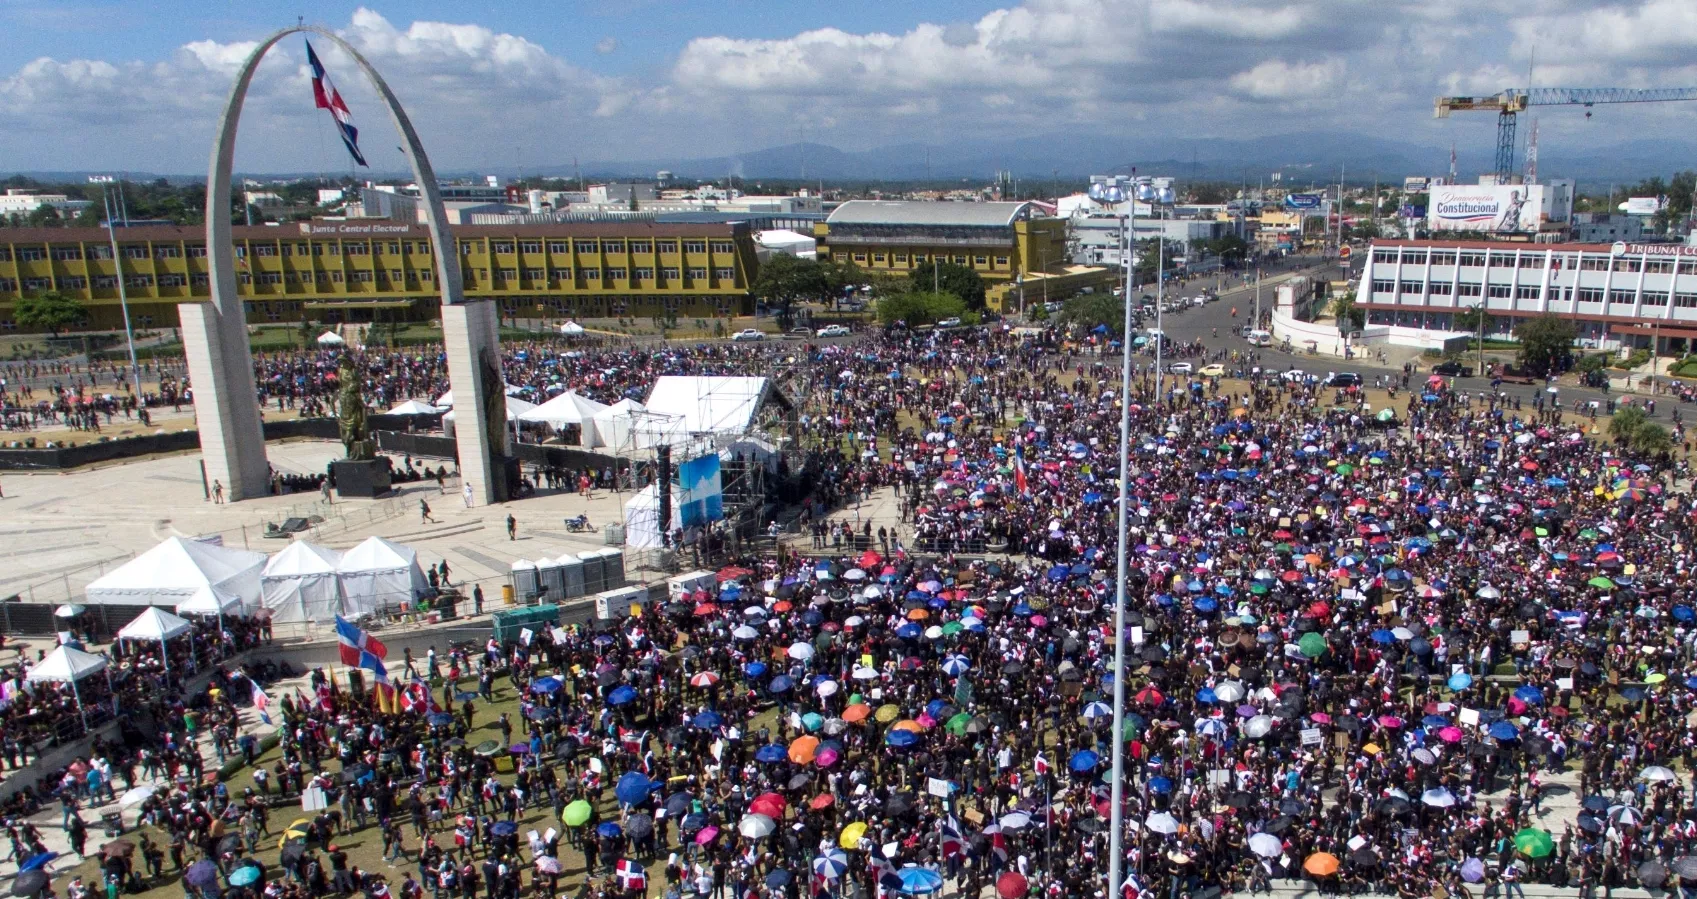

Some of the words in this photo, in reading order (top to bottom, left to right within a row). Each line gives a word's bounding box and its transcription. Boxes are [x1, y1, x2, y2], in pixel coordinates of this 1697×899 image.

[1441, 192, 1494, 204] Democracia
[1437, 202, 1499, 213] Constitucional
[312, 225, 336, 233] Junta
[339, 224, 371, 233] Central
[373, 224, 409, 233] Electoral
[1630, 244, 1682, 255] TRIBUNAL
